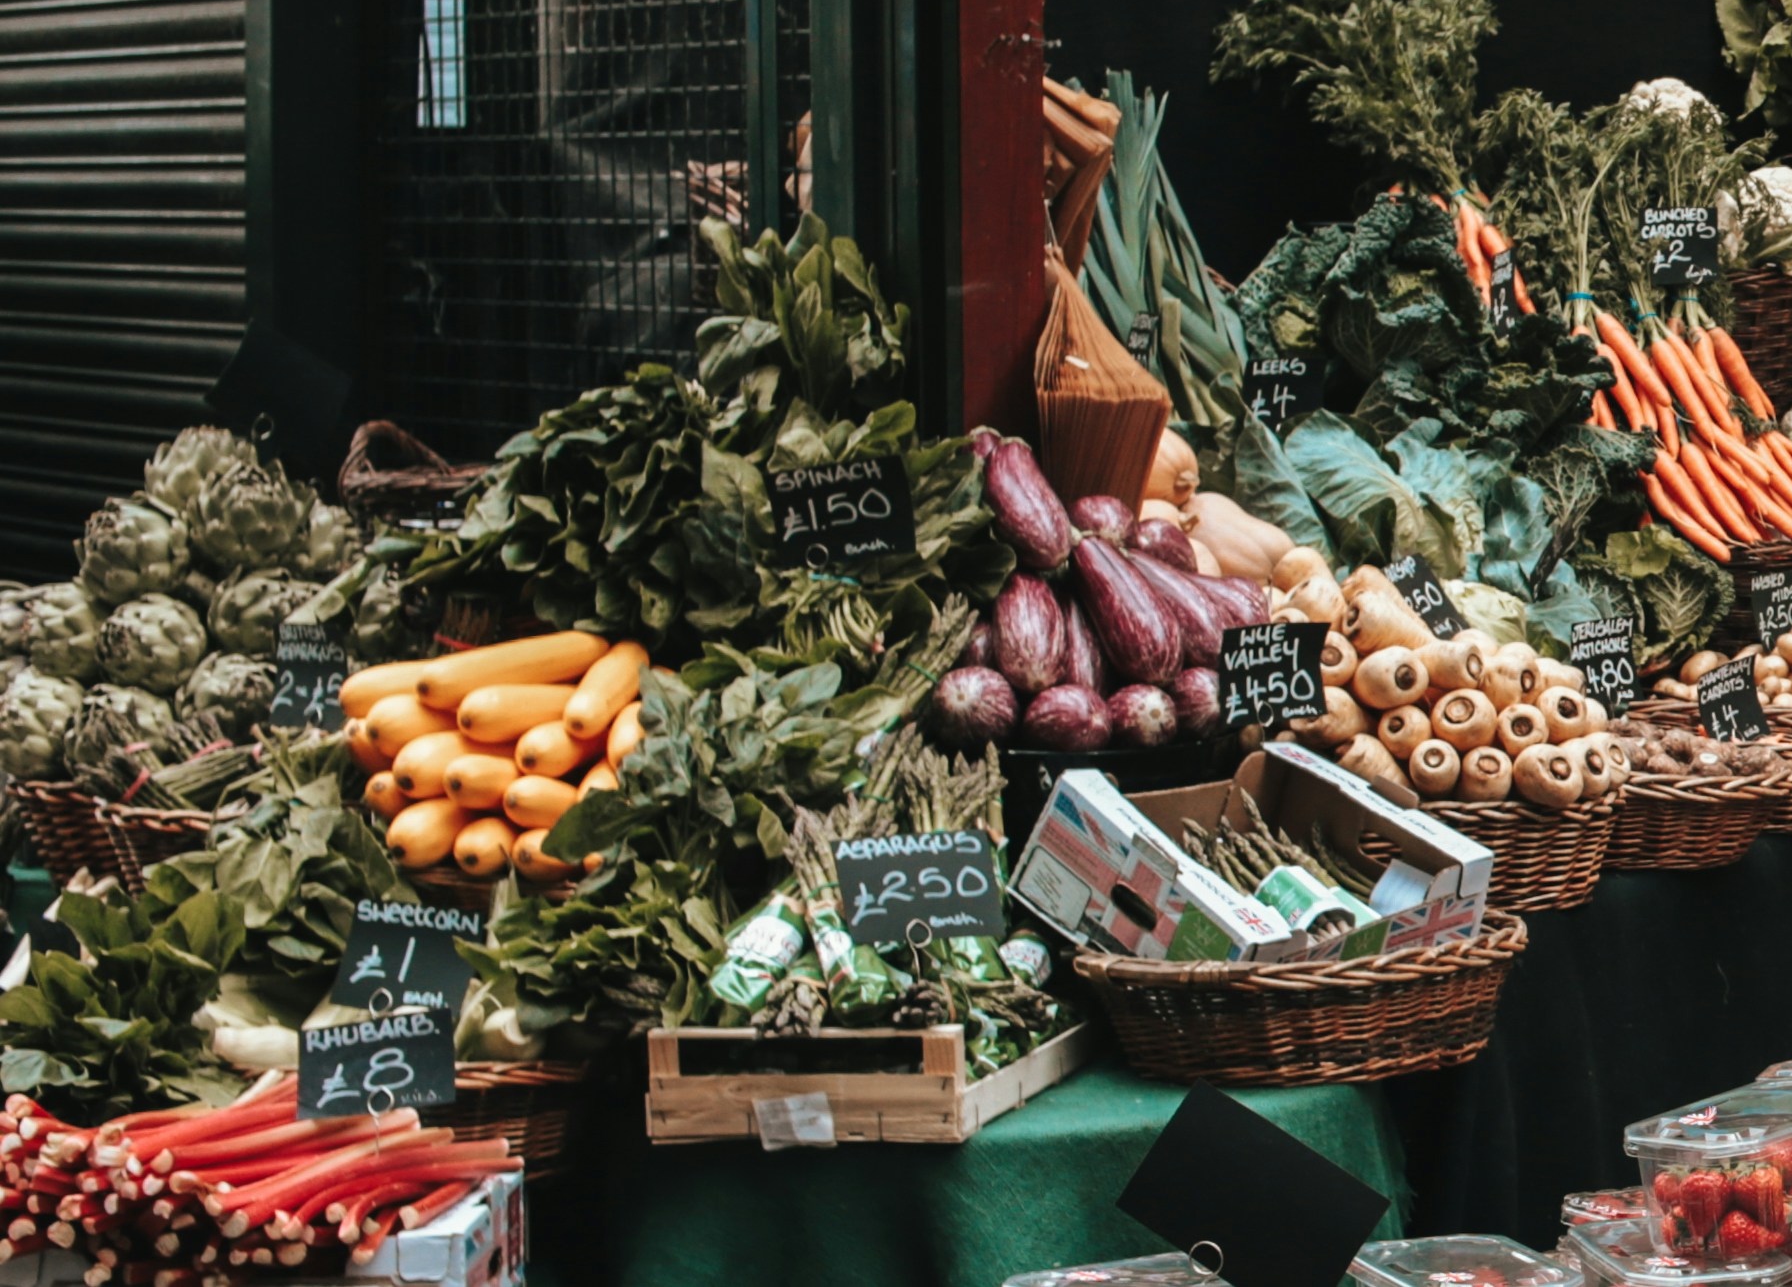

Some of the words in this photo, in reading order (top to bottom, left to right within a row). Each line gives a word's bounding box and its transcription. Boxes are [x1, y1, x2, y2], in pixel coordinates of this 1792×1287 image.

[1641, 222, 1716, 240] CARROTS
[1643, 207, 1708, 224] BUNCHED
[1654, 239, 1692, 275] £2
[1252, 357, 1306, 376] LEEKS
[1249, 383, 1297, 419] £4
[775, 461, 883, 493] SPINACH
[782, 488, 893, 542] £1.50
[1571, 517, 1635, 544] JERUSALEM
[1240, 623, 1286, 649] WYE
[1570, 635, 1630, 662] ARTICHOKE
[1224, 636, 1300, 671] VALLEY
[1696, 657, 1752, 690] CHANTENAY
[1710, 704, 1740, 740] £4
[835, 830, 981, 861] ASPARAGUS
[852, 864, 989, 927] £2.50
[350, 937, 415, 983] £1
[317, 1046, 414, 1108] £8
